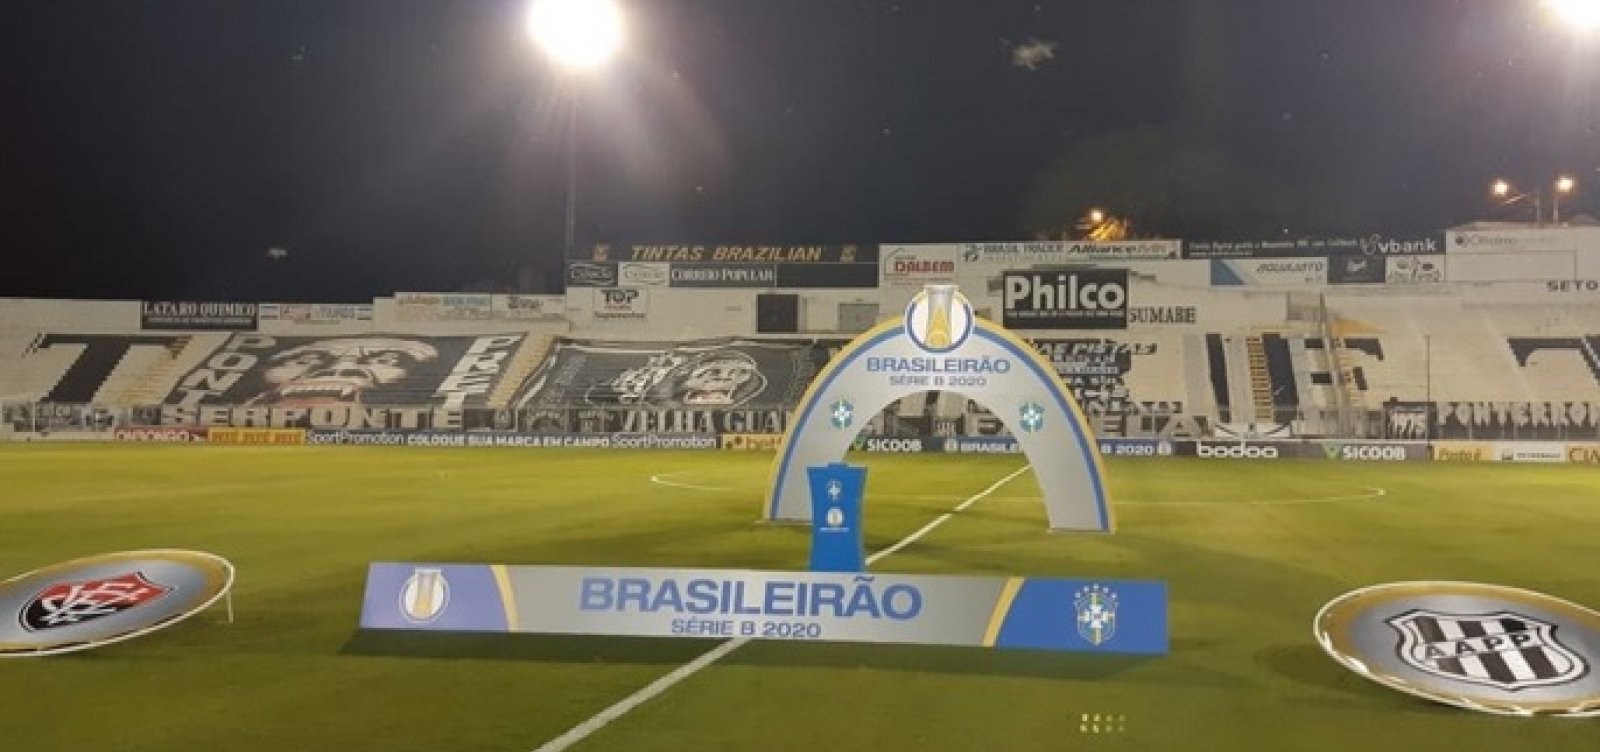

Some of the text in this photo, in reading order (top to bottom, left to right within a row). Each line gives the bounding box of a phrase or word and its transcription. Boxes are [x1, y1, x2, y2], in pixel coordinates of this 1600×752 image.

[1378, 238, 1437, 253] vbank
[630, 246, 823, 261] TINTAS BRAZILIAN
[601, 289, 640, 304] TOP
[1005, 274, 1125, 310] Philco
[866, 354, 1011, 374] BRASILEIRÃO
[888, 374, 929, 386] SÉRIE
[948, 375, 988, 386] 2020
[161, 404, 463, 429] SERPONTE
[621, 410, 715, 433] VELHA
[407, 433, 465, 447] COLOQUE
[496, 434, 540, 447] MARCA
[542, 435, 562, 447] EM
[564, 435, 610, 448] CAMPO
[866, 439, 922, 451] SICOOB
[1114, 443, 1153, 454] 2020
[1342, 446, 1406, 460] SICOOB
[578, 575, 923, 620] BRASILEIRÃO
[670, 617, 822, 638] SÉRIE B 2020
[1424, 632, 1532, 658] AAPP
